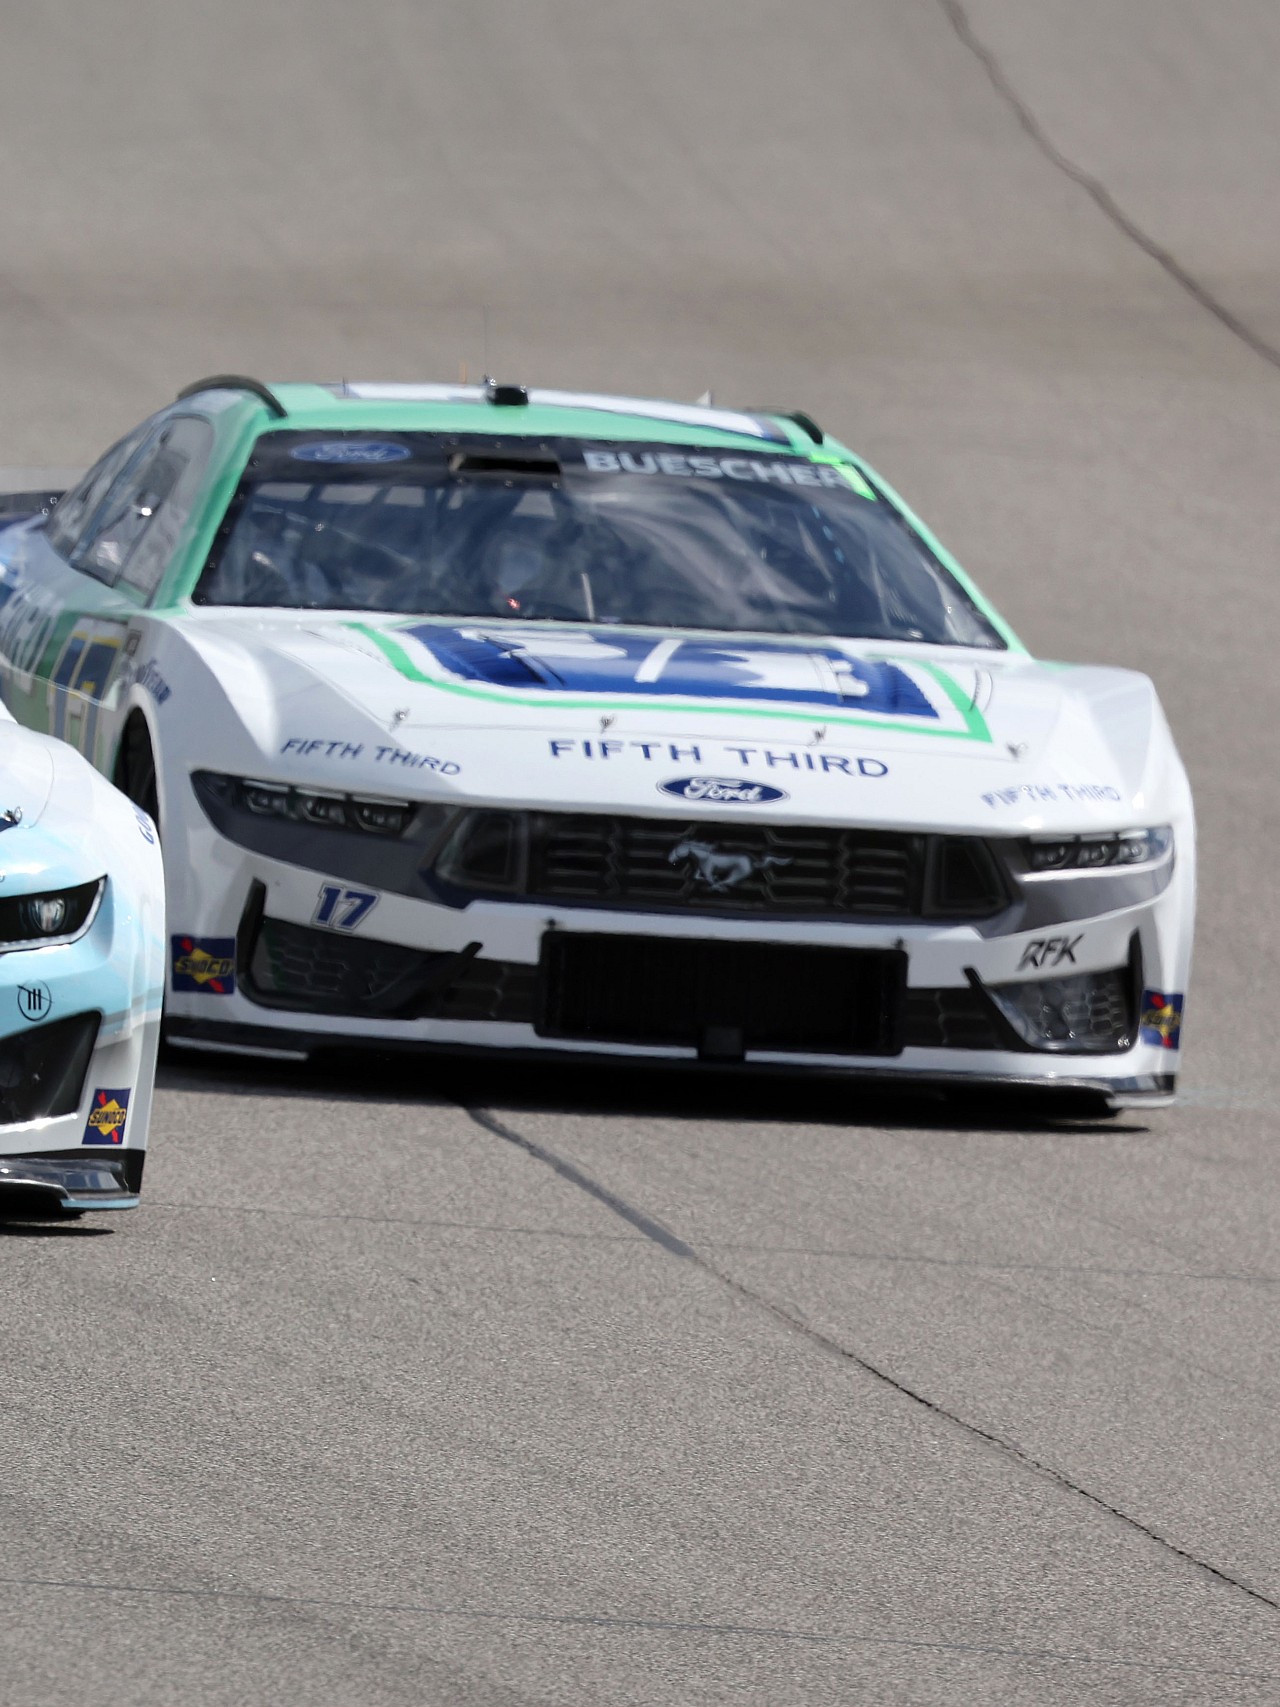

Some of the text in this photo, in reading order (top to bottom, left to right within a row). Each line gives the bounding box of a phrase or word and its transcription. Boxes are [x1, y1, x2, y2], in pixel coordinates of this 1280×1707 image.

[582, 448, 854, 489] BUESCHER
[281, 738, 461, 776] FIFTH THIRD
[550, 739, 890, 778] FIFTH THIRD
[683, 778, 764, 802] Ford
[311, 884, 381, 933] 17
[1016, 933, 1085, 972] RFK
